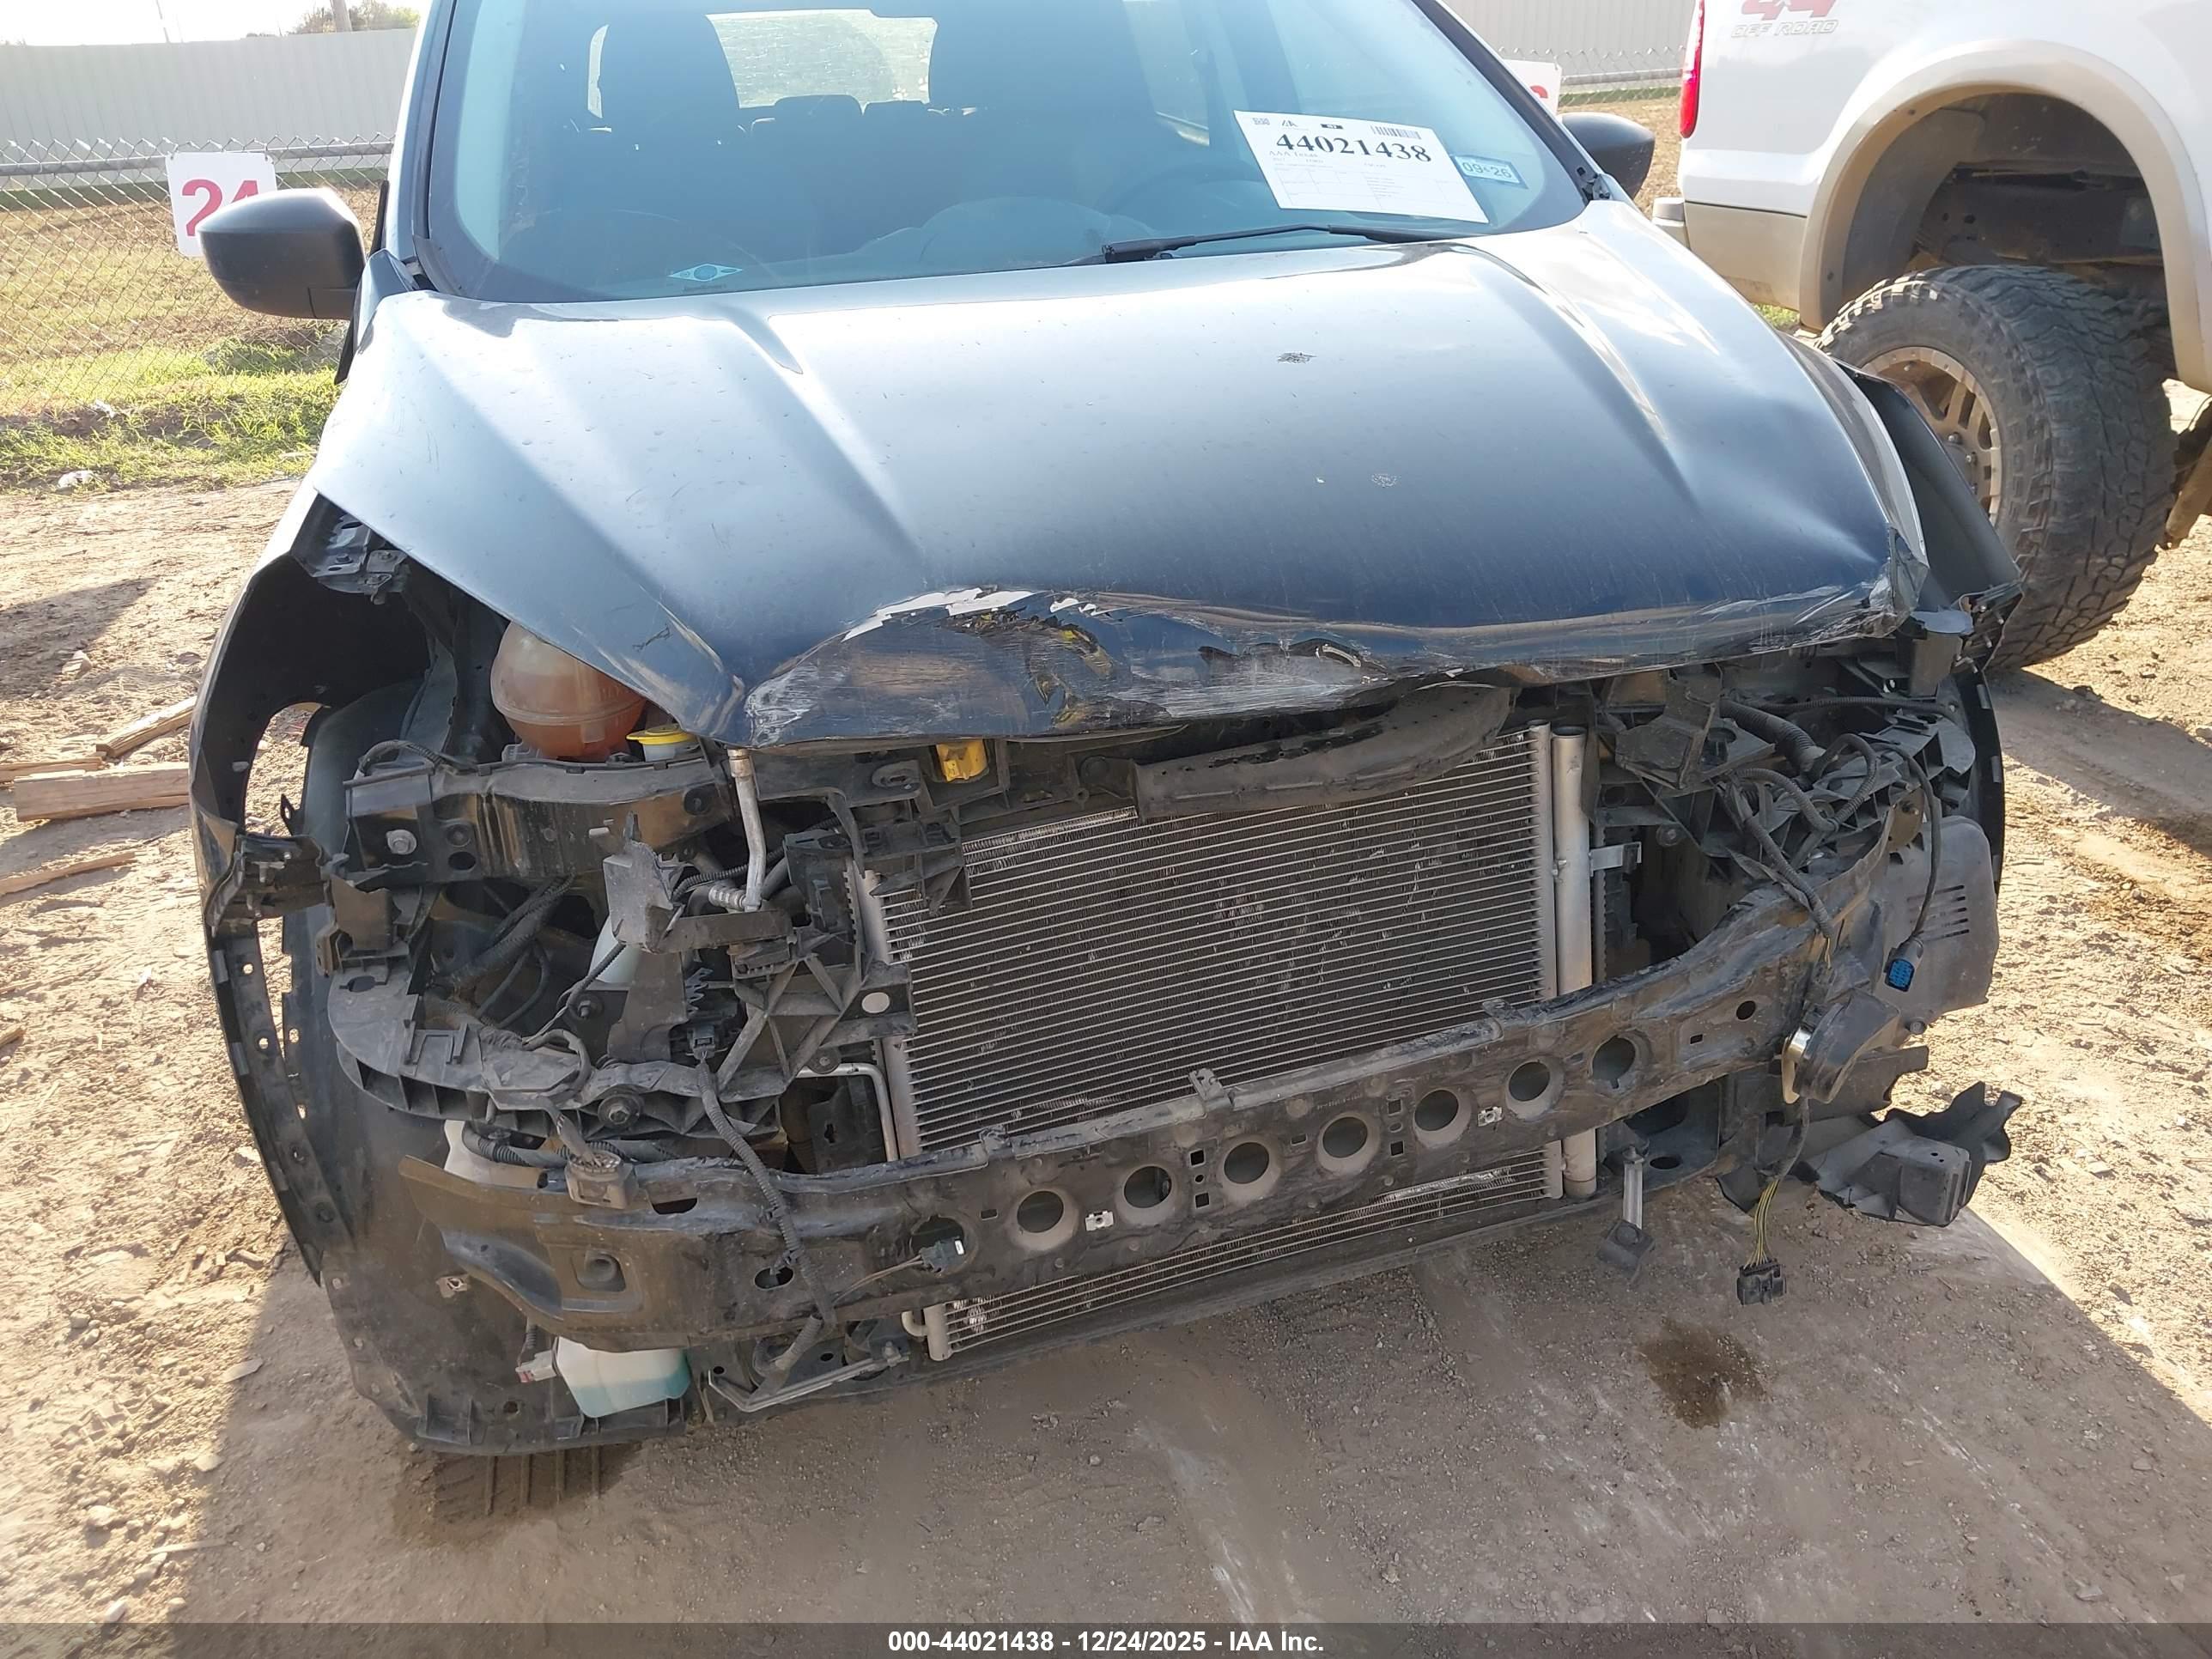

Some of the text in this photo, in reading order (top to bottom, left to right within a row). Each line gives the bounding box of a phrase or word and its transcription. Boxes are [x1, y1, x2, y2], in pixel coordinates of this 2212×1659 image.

[1730, 20, 1838, 38] OFF ROAD
[1276, 133, 1431, 162] 44021438
